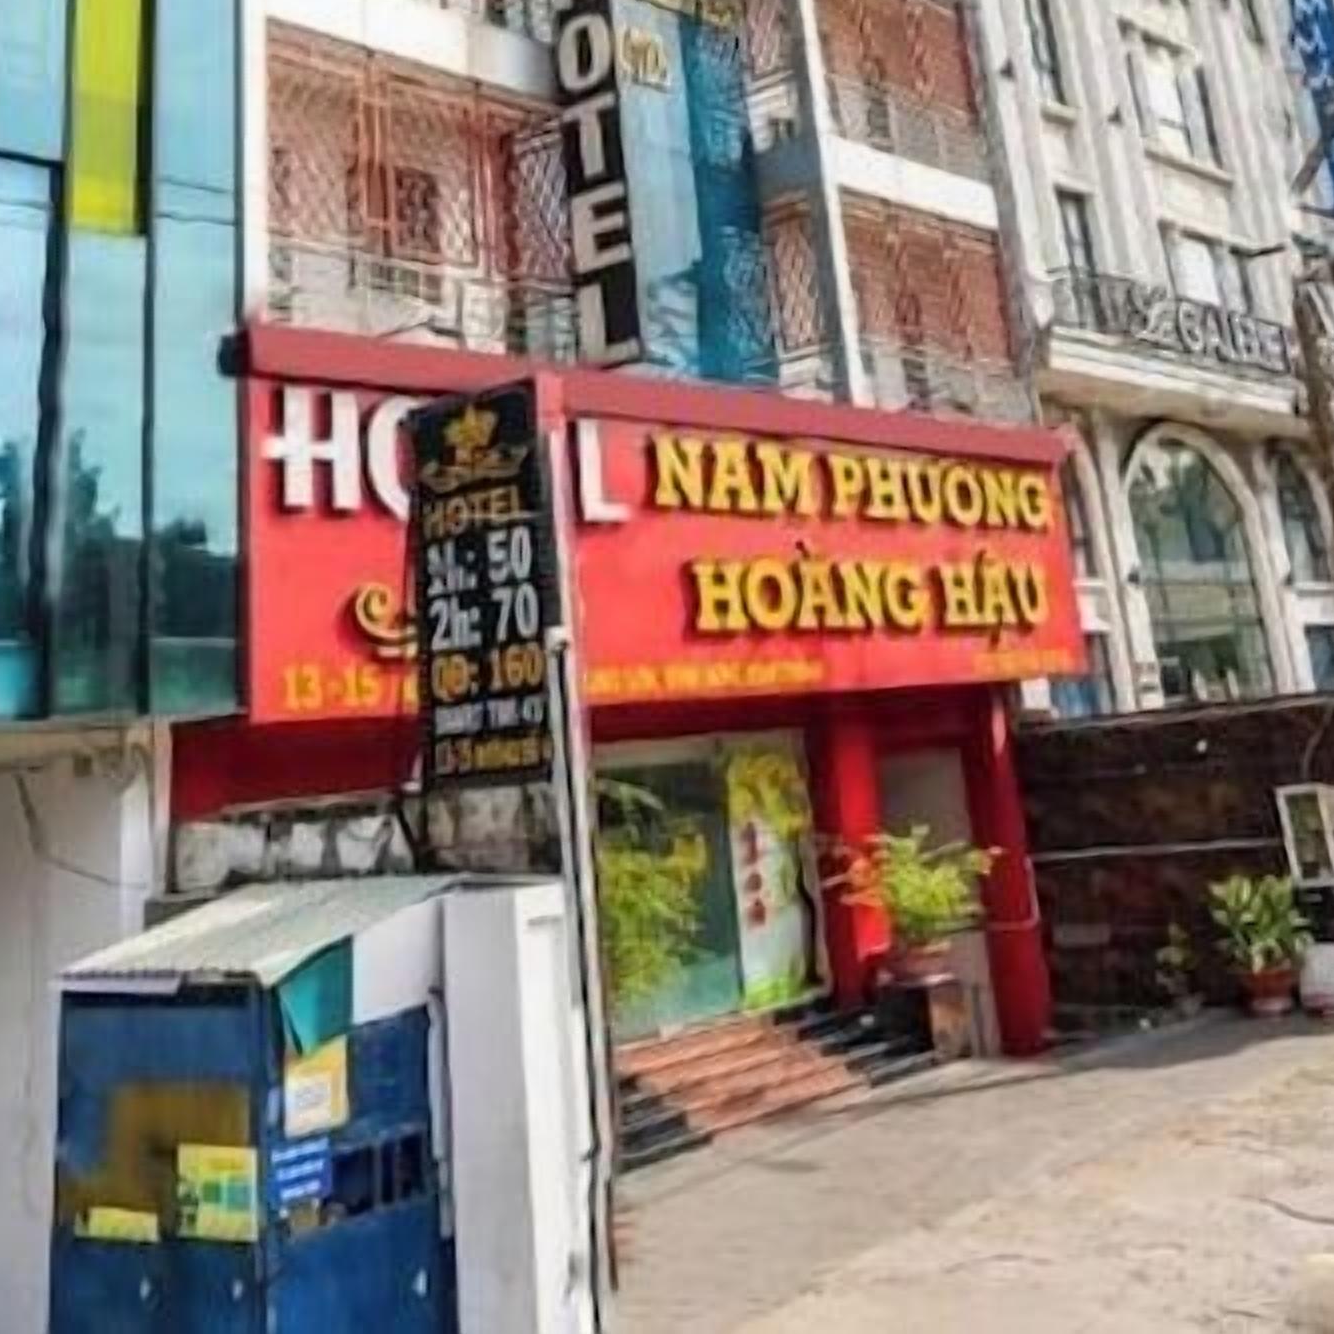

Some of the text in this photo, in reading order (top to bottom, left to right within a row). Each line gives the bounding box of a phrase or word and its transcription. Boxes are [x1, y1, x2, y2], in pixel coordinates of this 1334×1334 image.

[650, 432, 820, 519] NAM
[423, 486, 535, 540] HOTEL
[486, 525, 534, 584] 50
[490, 580, 540, 643] 70
[490, 639, 546, 692] 160
